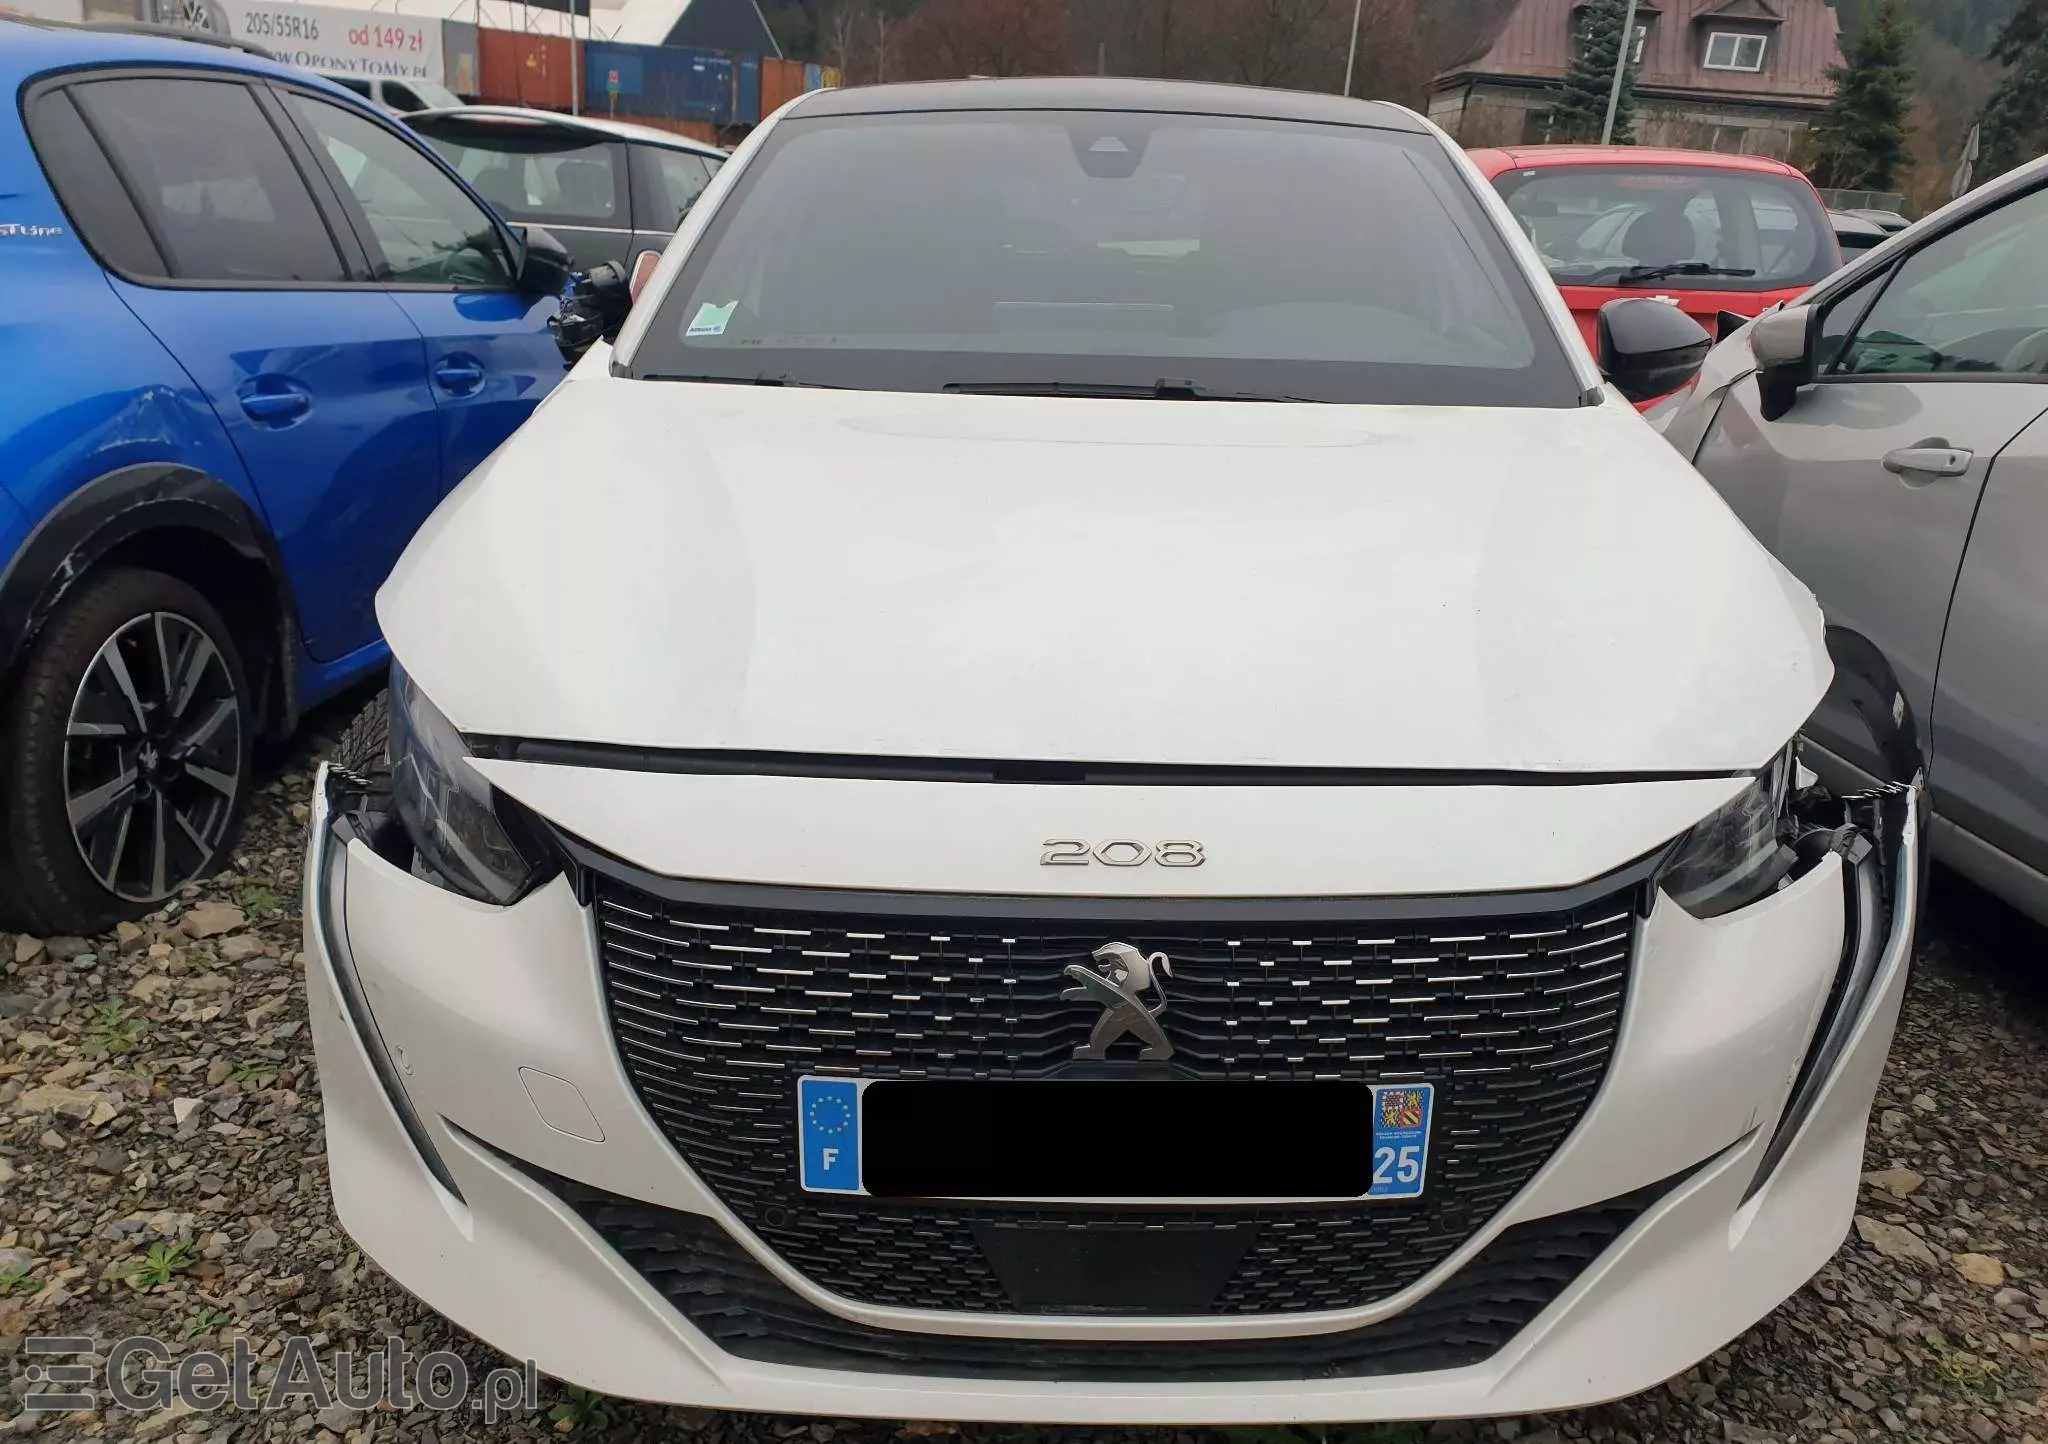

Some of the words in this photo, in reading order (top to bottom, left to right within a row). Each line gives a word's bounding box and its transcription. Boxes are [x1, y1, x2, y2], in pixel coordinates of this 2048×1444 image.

[244, 12, 319, 40] 205/55R16
[348, 24, 369, 45] od
[373, 25, 404, 48] 149
[1039, 838, 1206, 868] 208
[823, 1147, 840, 1171] F
[1372, 1145, 1420, 1184] 25
